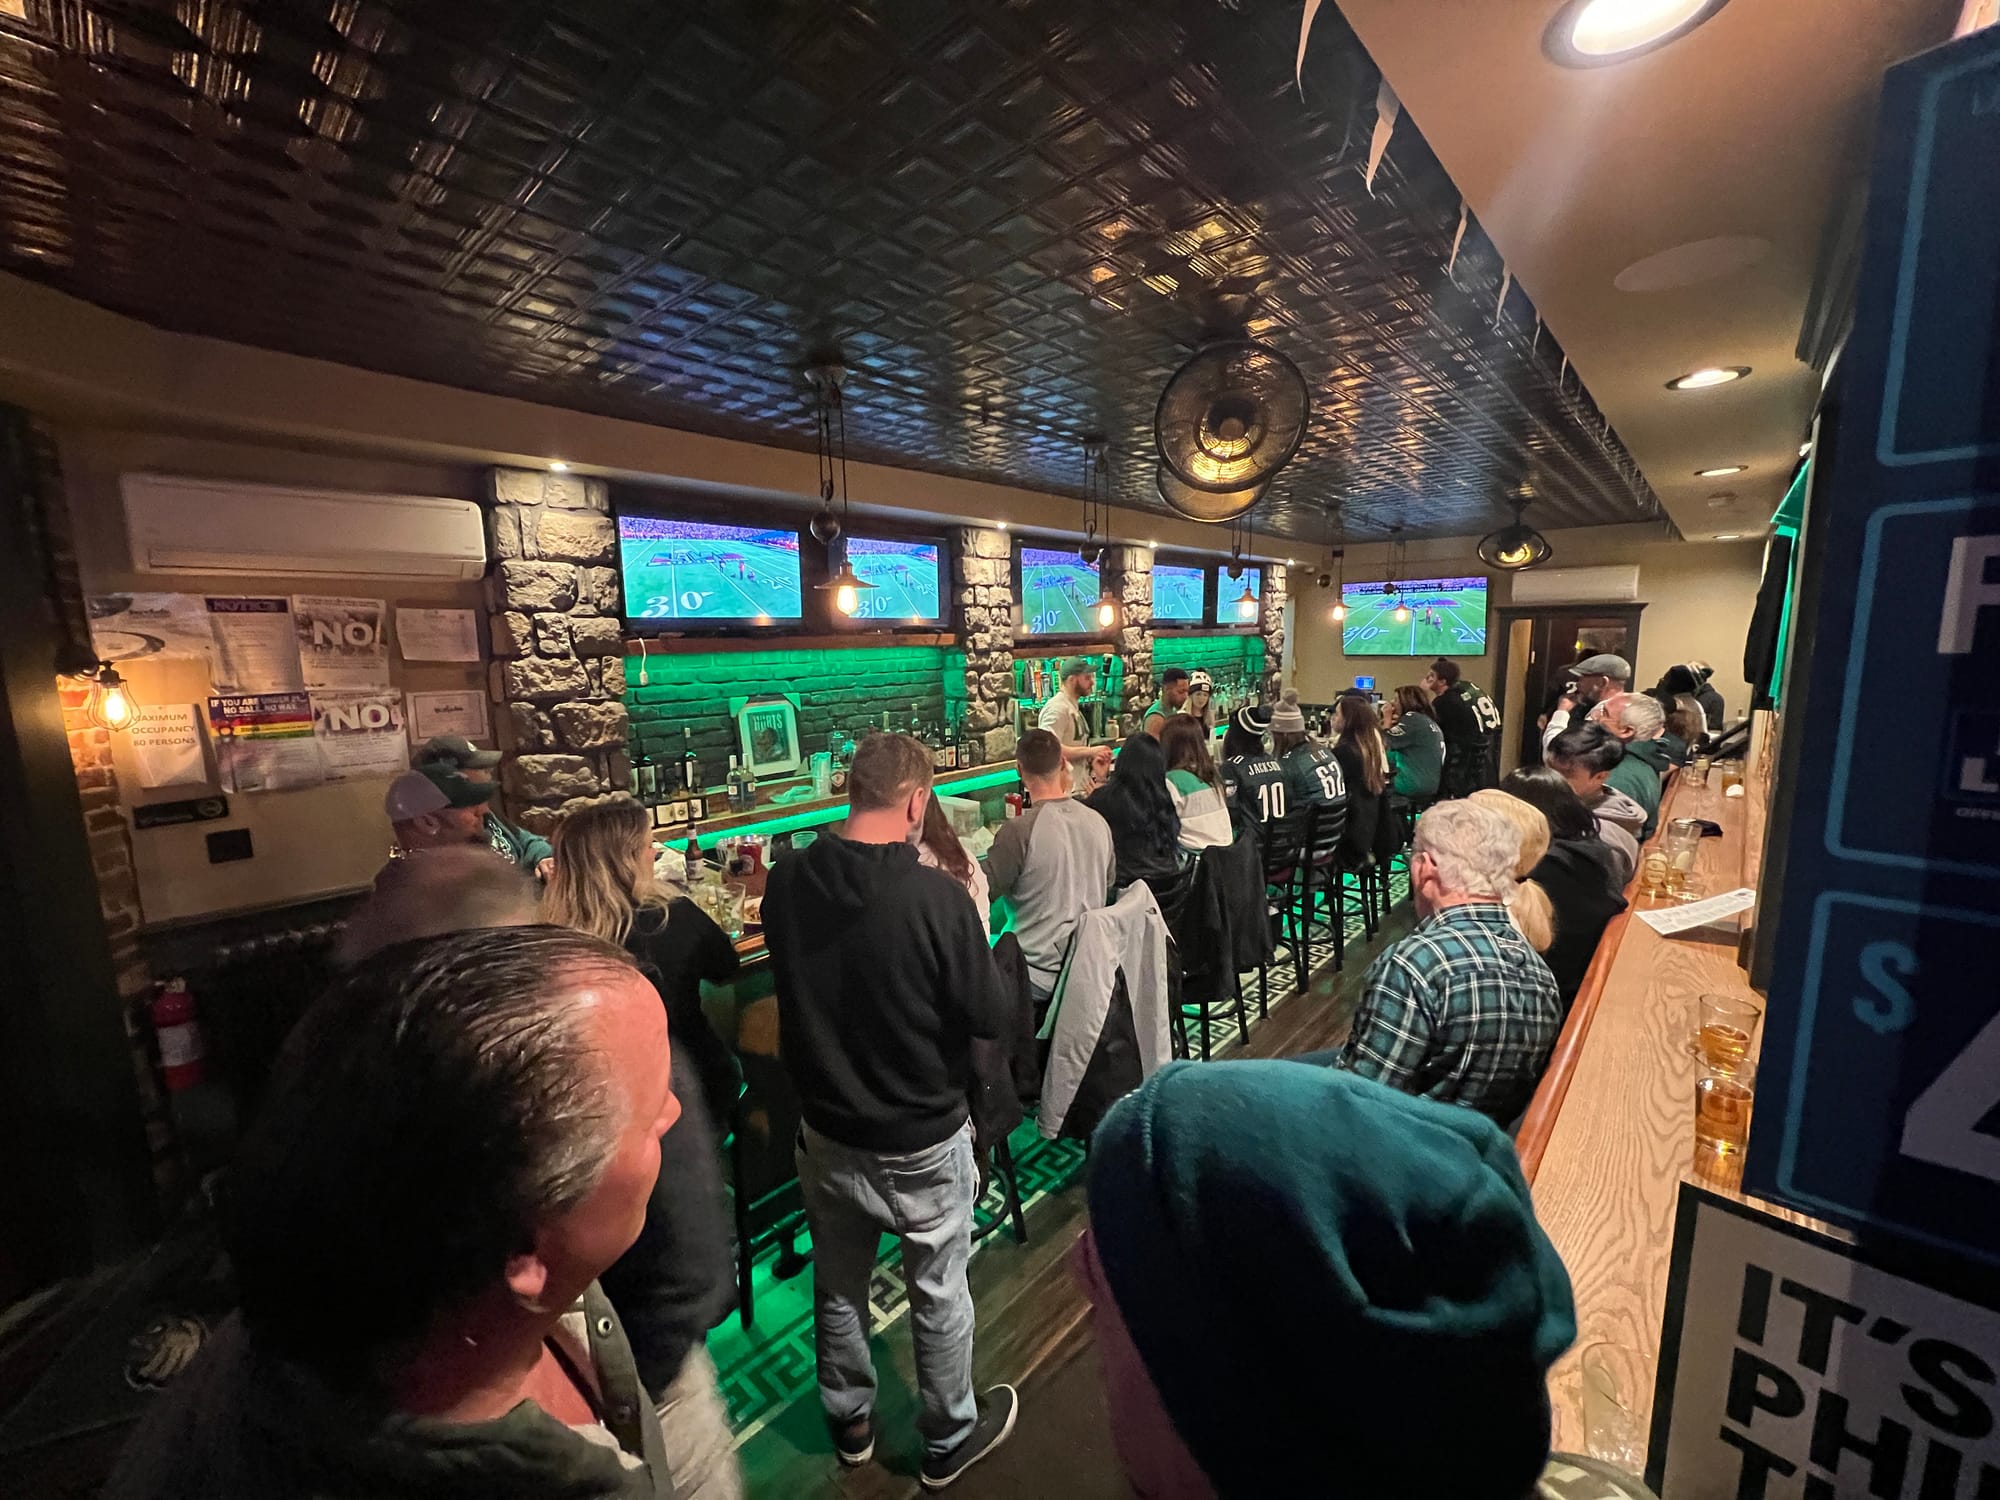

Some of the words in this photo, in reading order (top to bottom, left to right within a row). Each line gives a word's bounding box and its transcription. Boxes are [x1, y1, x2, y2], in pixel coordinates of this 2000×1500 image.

[223, 707, 237, 715] NO
[132, 713, 188, 722] MAXIMUM
[131, 725, 196, 735] OCCUPANCY
[149, 737, 196, 746] PERSONS
[1315, 761, 1346, 800] 62
[1257, 781, 1285, 823] 10
[1737, 1263, 1998, 1440] IT'S
